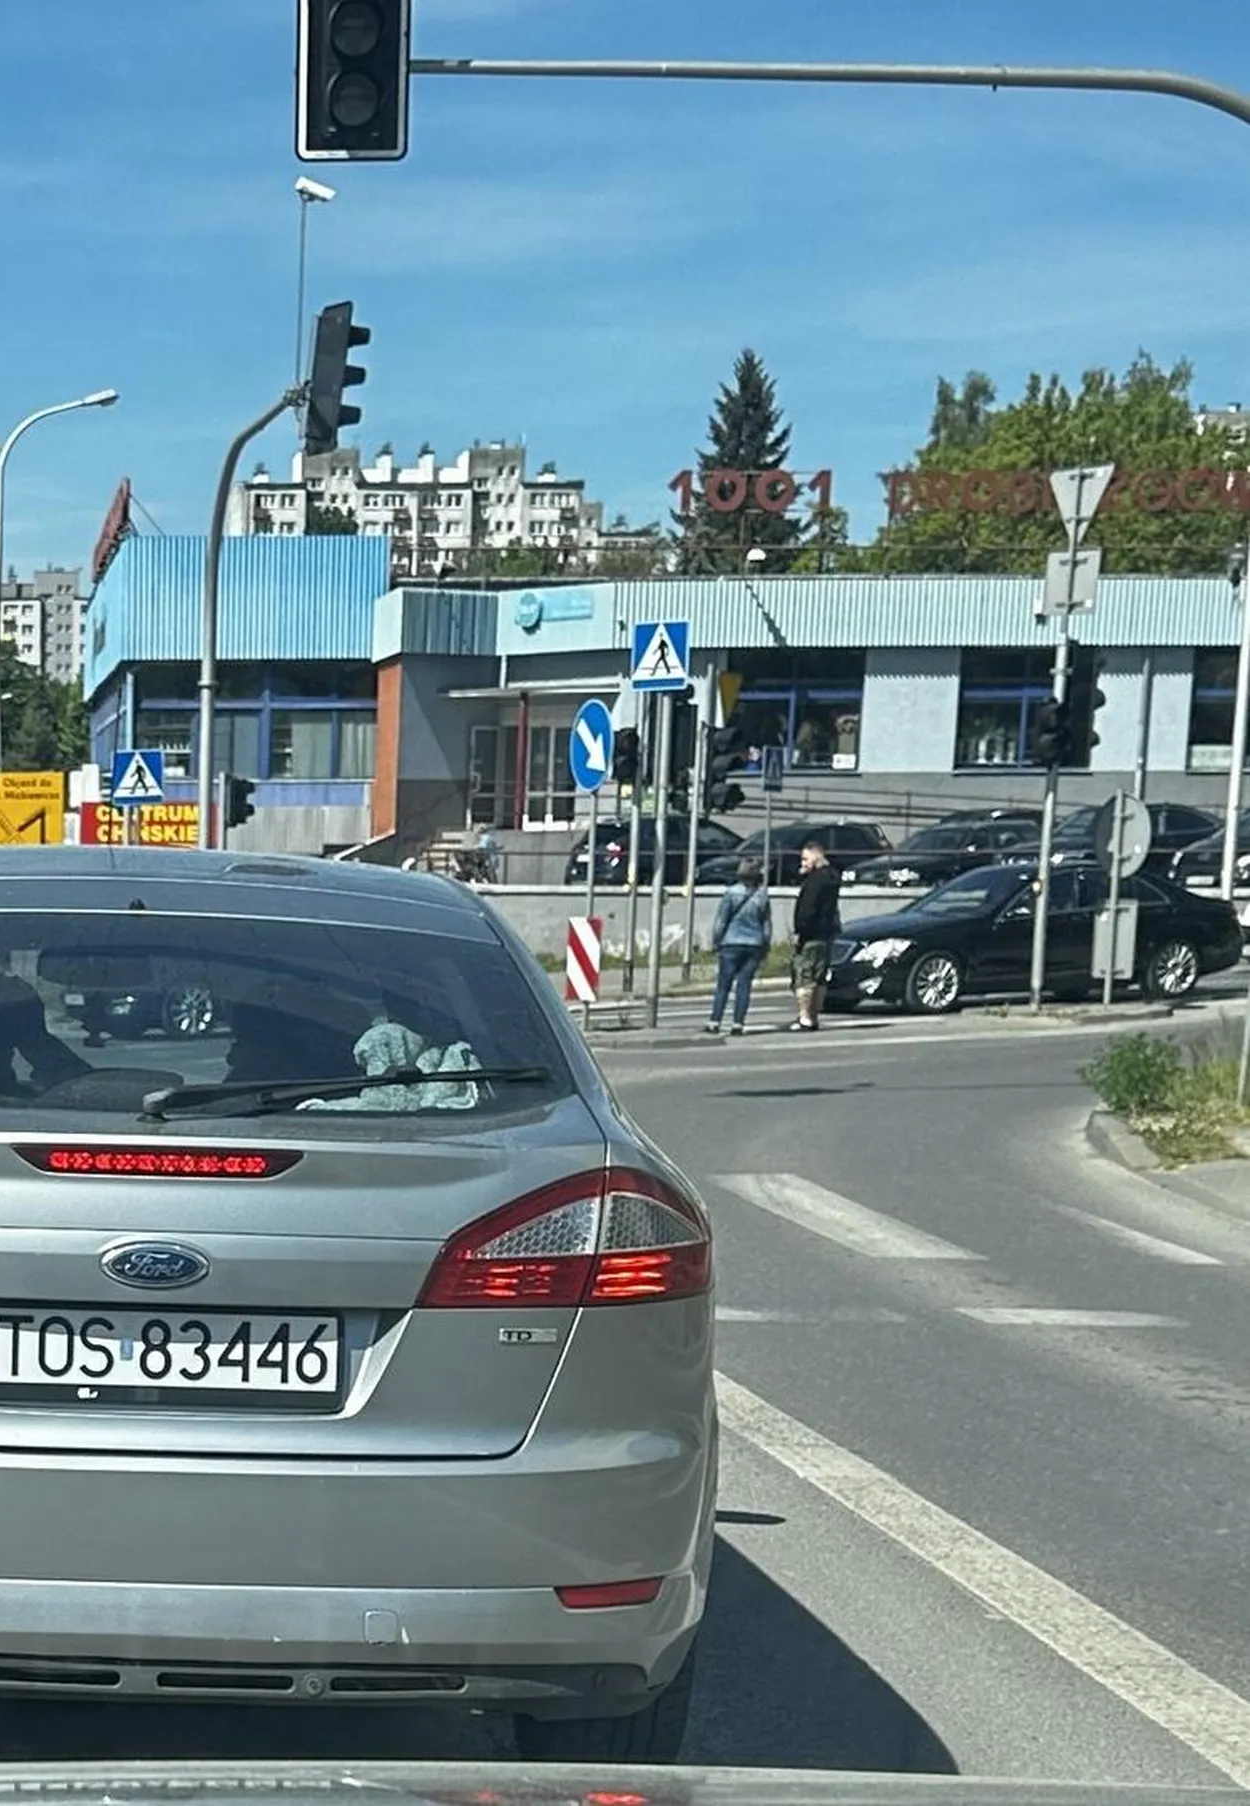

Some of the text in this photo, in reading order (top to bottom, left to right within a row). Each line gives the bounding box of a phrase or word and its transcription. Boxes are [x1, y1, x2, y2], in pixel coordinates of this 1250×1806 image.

[668, 469, 832, 513] 1001
[124, 1252, 184, 1276] Ford
[139, 1318, 329, 1385] 83446
